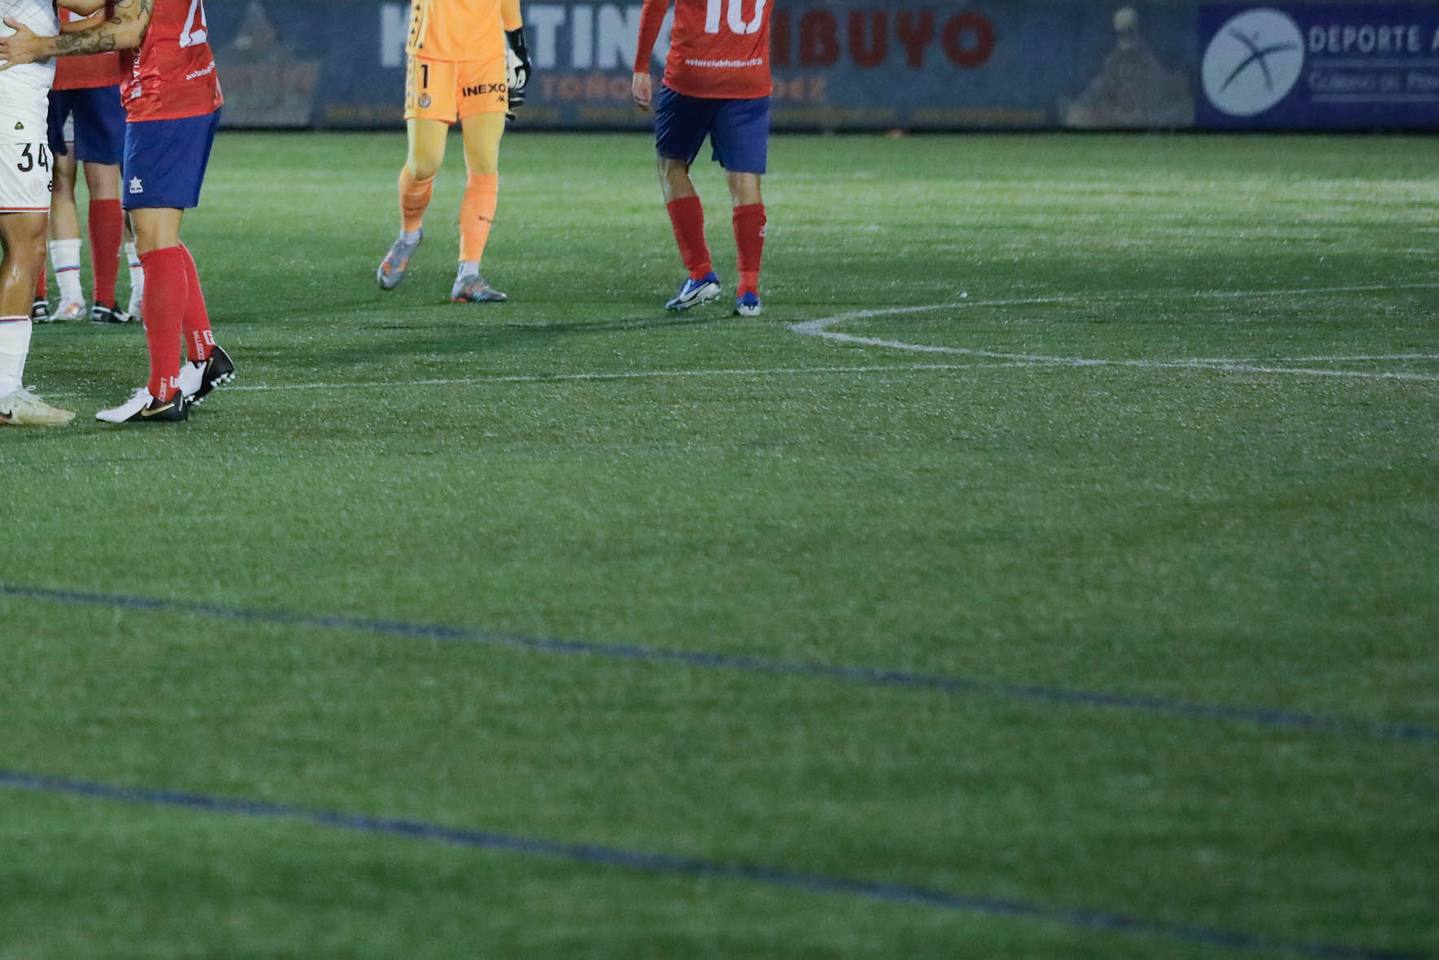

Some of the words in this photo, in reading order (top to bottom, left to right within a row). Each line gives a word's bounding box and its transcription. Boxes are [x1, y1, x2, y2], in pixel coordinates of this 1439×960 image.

[1308, 25, 1421, 53] DEPORTE
[420, 63, 429, 89] 1
[462, 82, 506, 97] INEXO
[16, 142, 48, 172] 34
